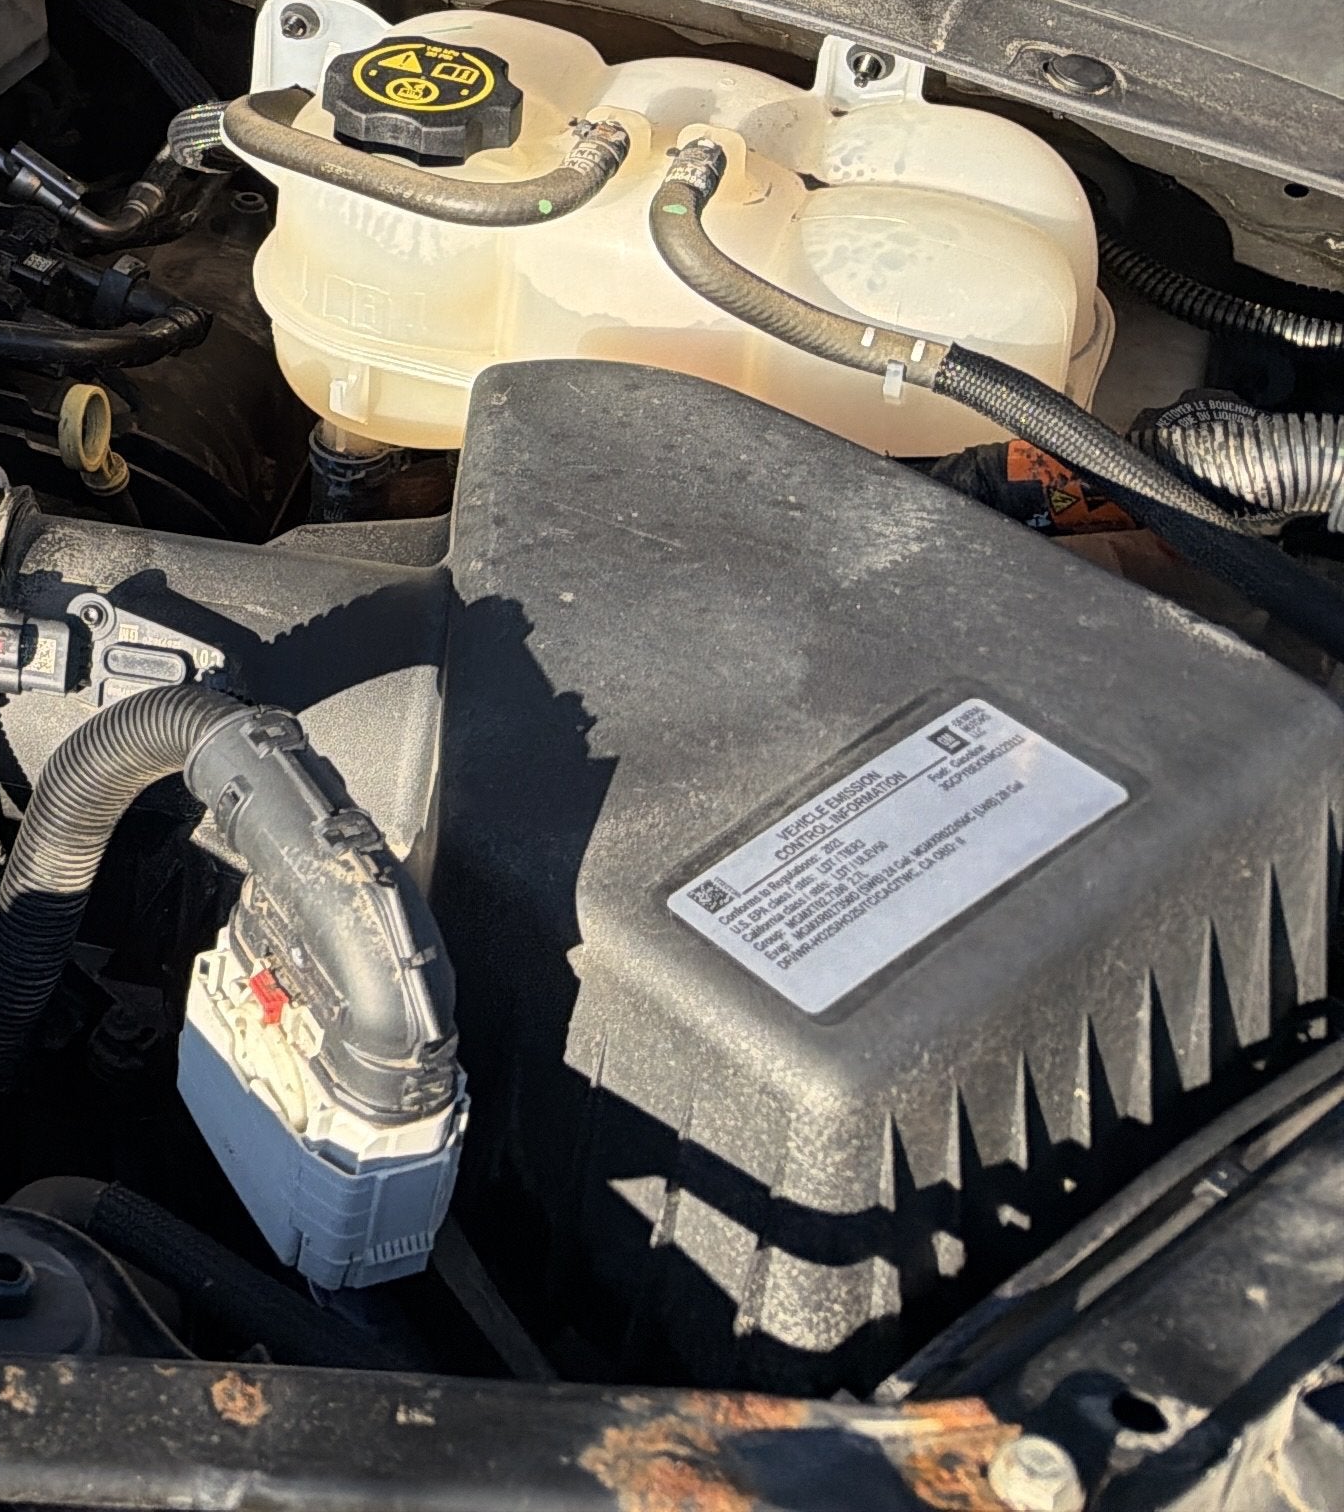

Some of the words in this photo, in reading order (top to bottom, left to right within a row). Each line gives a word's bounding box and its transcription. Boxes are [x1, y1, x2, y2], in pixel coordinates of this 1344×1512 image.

[1193, 400, 1207, 410] LE
[1209, 399, 1256, 417] BOUCHON
[774, 820, 834, 861] CONTROL
[828, 771, 907, 824] INFORMATION
[777, 806, 829, 841] VEHICLE
[825, 771, 881, 808] EMISSION
[718, 895, 761, 925] Conforms
[758, 888, 772, 898] to
[767, 853, 824, 892] Regulations:
[820, 838, 844, 854] 2021
[741, 912, 785, 942] California
[781, 897, 807, 915] class
[832, 866, 852, 880] LDT
[853, 841, 888, 865] ULEV50
[919, 857, 938, 869] CA
[730, 919, 751, 933] U.S.
[747, 906, 769, 921] EPA
[764, 890, 791, 909] class
[792, 873, 817, 890] stds:
[753, 928, 787, 952] Group:
[765, 940, 794, 961] Evap:
